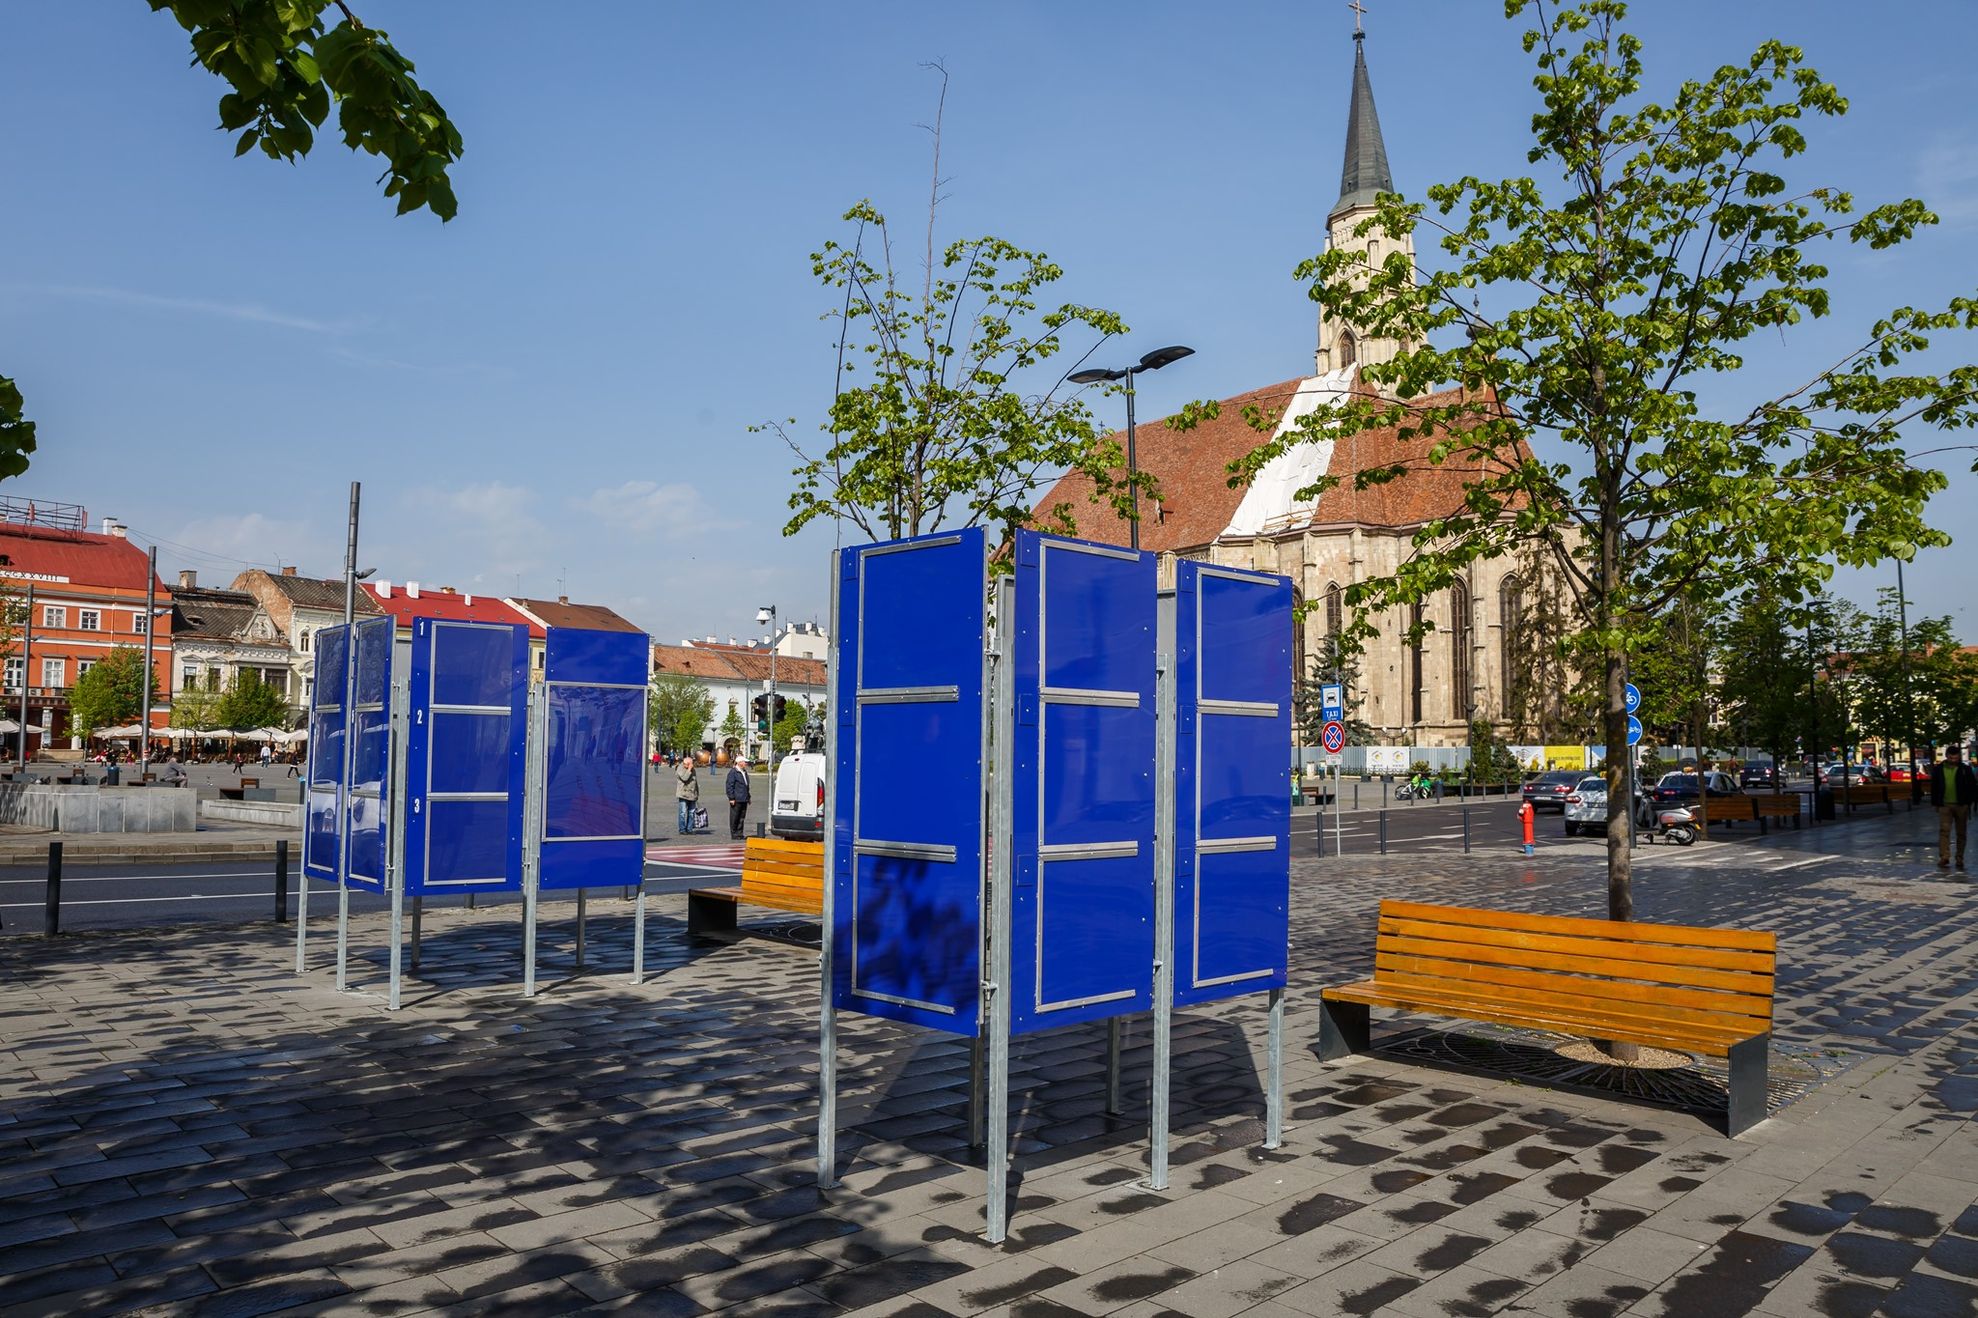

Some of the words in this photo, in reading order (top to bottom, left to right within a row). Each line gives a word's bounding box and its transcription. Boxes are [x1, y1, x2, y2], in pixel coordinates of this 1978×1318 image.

[0, 571, 57, 581] CCXXVIII
[420, 621, 425, 636] 1
[417, 709, 423, 724] 2
[414, 798, 420, 814] 3
